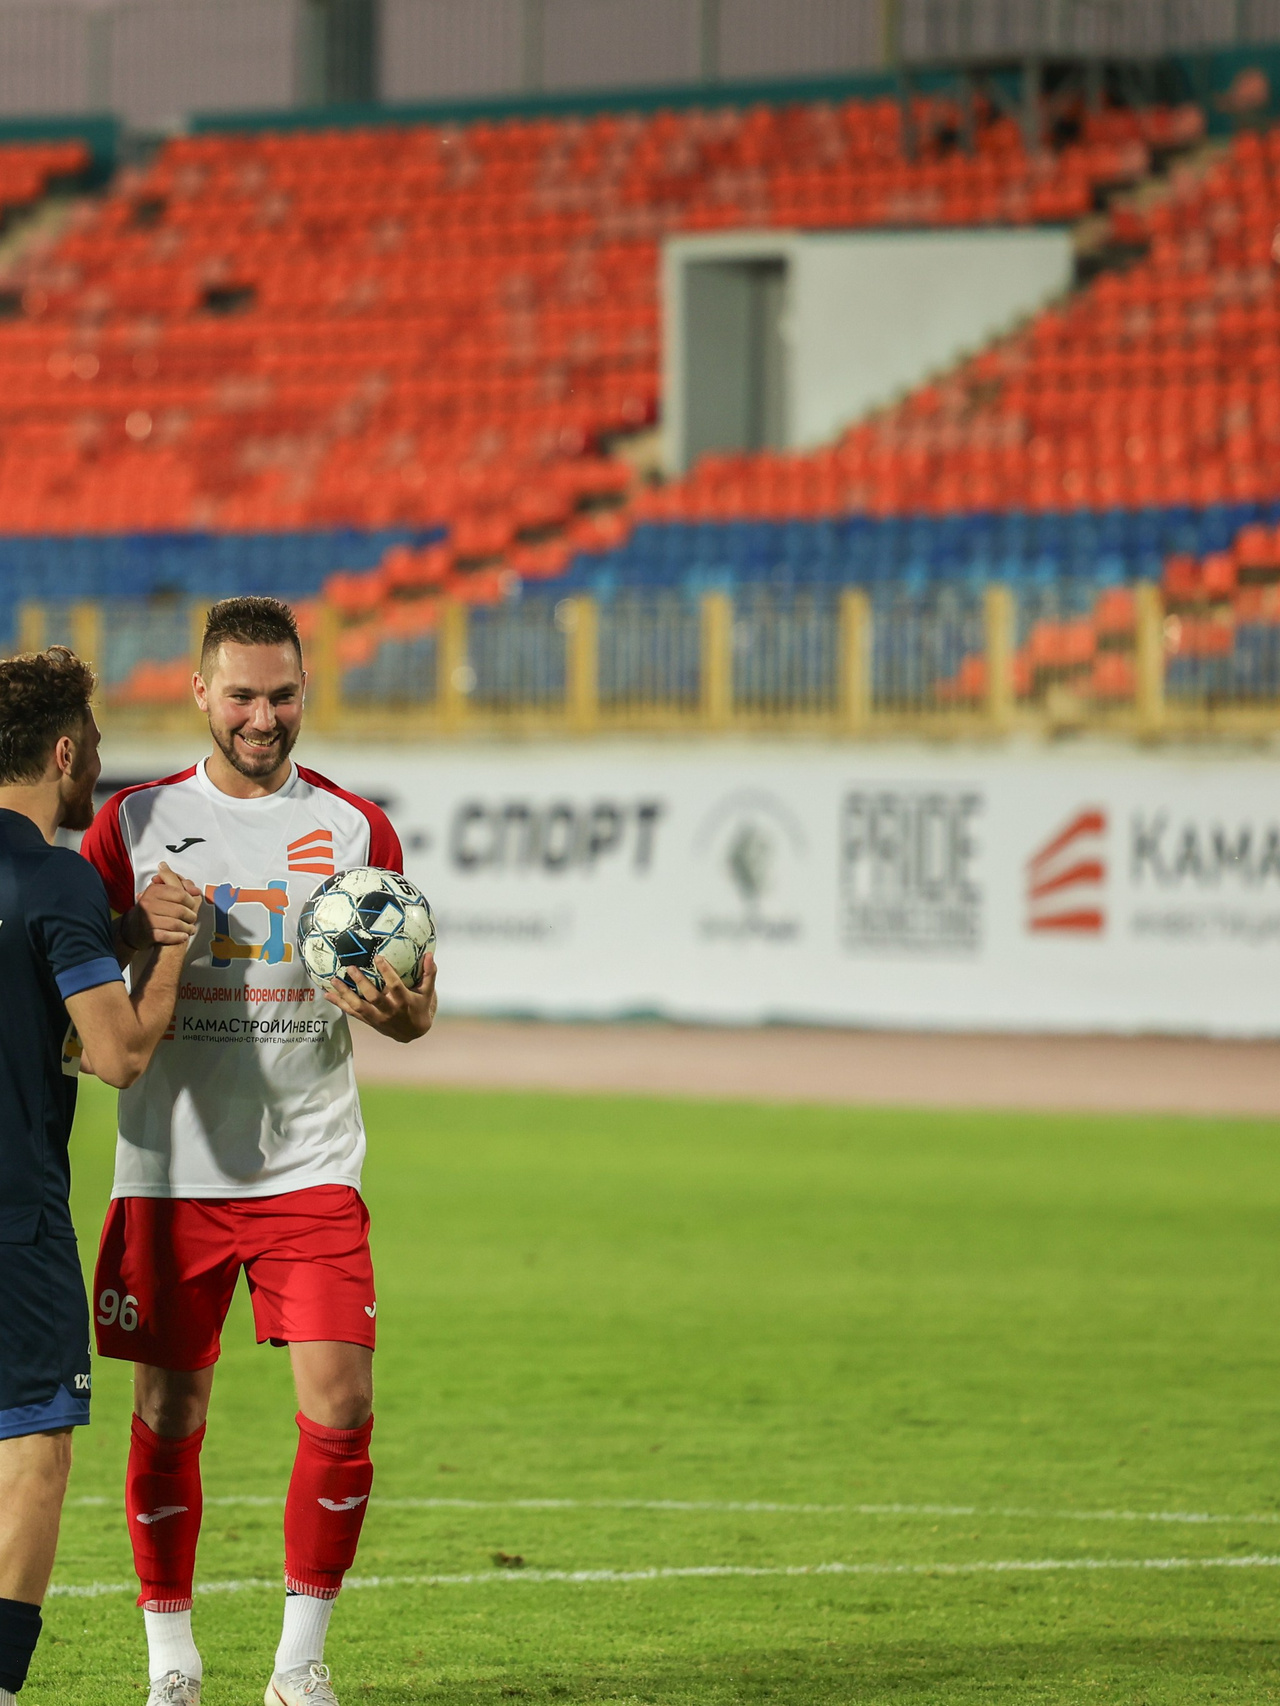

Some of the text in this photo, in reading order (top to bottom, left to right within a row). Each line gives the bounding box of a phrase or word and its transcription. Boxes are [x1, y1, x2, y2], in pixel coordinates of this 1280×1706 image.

[234, 988, 241, 1002] и
[243, 984, 286, 1006] боремся
[287, 987, 316, 1002] вместе
[97, 1288, 139, 1332] 96
[74, 1373, 91, 1390] 1X
